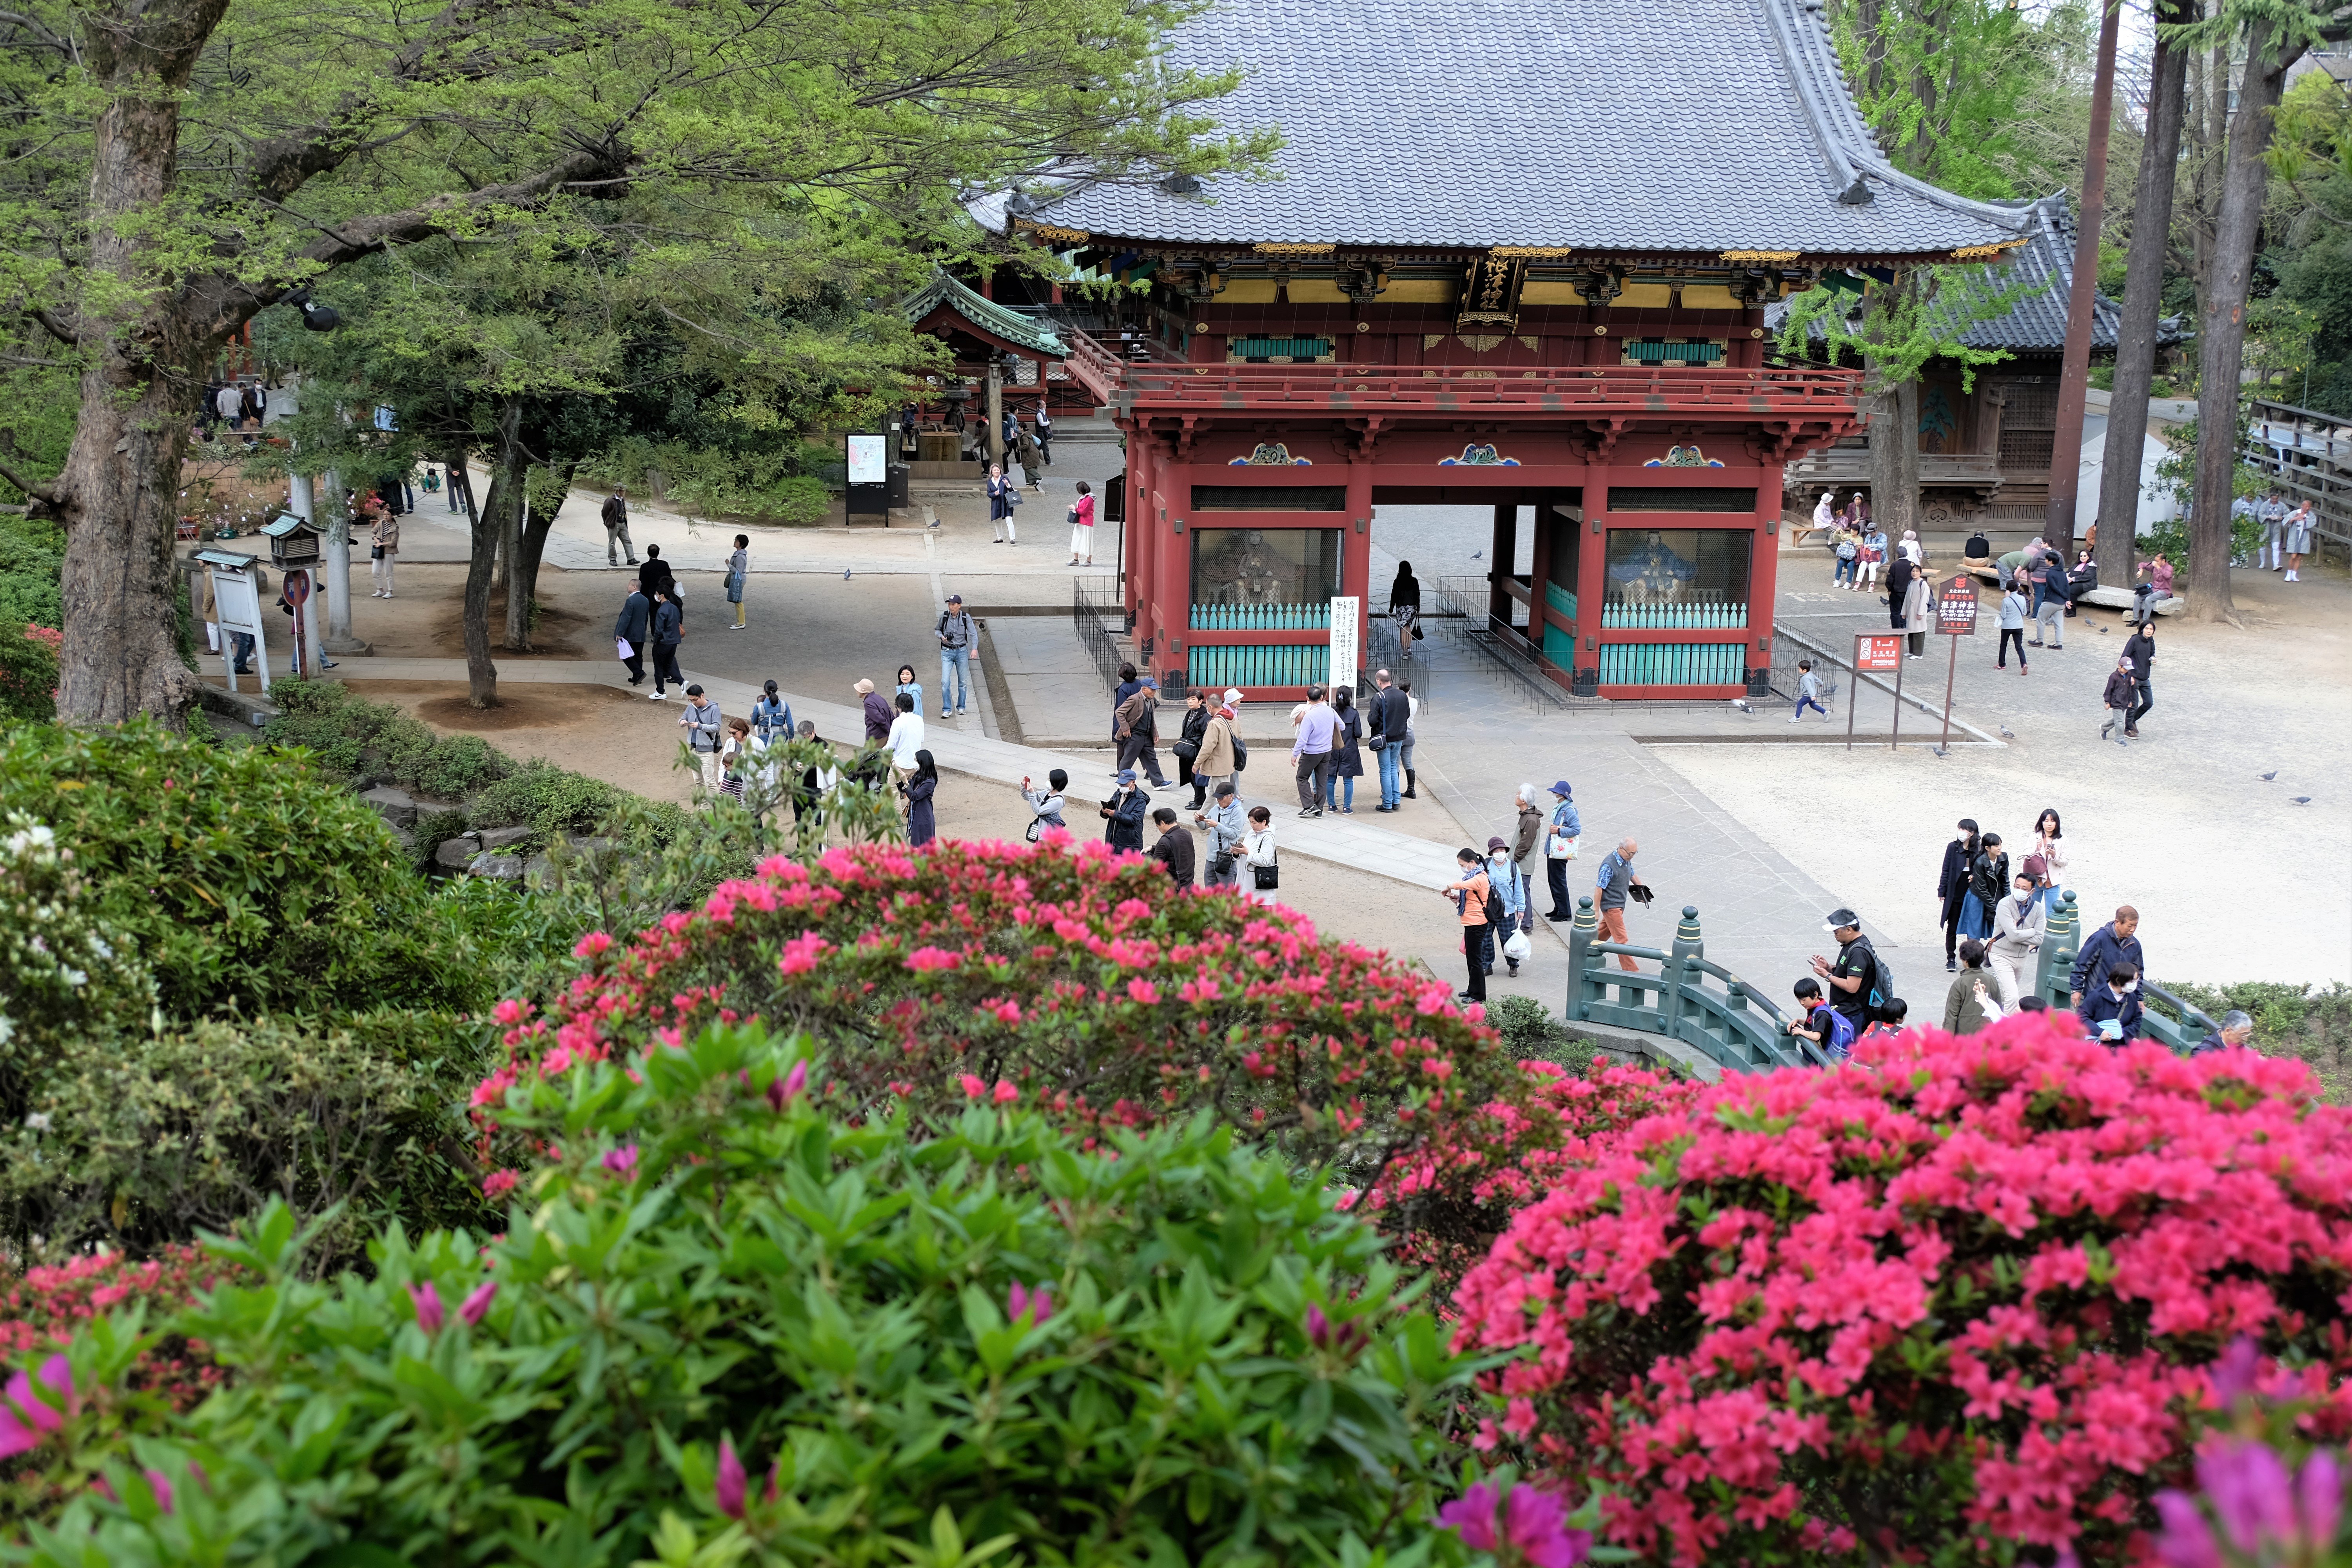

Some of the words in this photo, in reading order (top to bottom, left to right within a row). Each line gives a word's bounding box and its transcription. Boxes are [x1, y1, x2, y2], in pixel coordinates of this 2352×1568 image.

[1480, 257, 1509, 310] 根津神社
[1941, 601, 1975, 610] 根津神社
